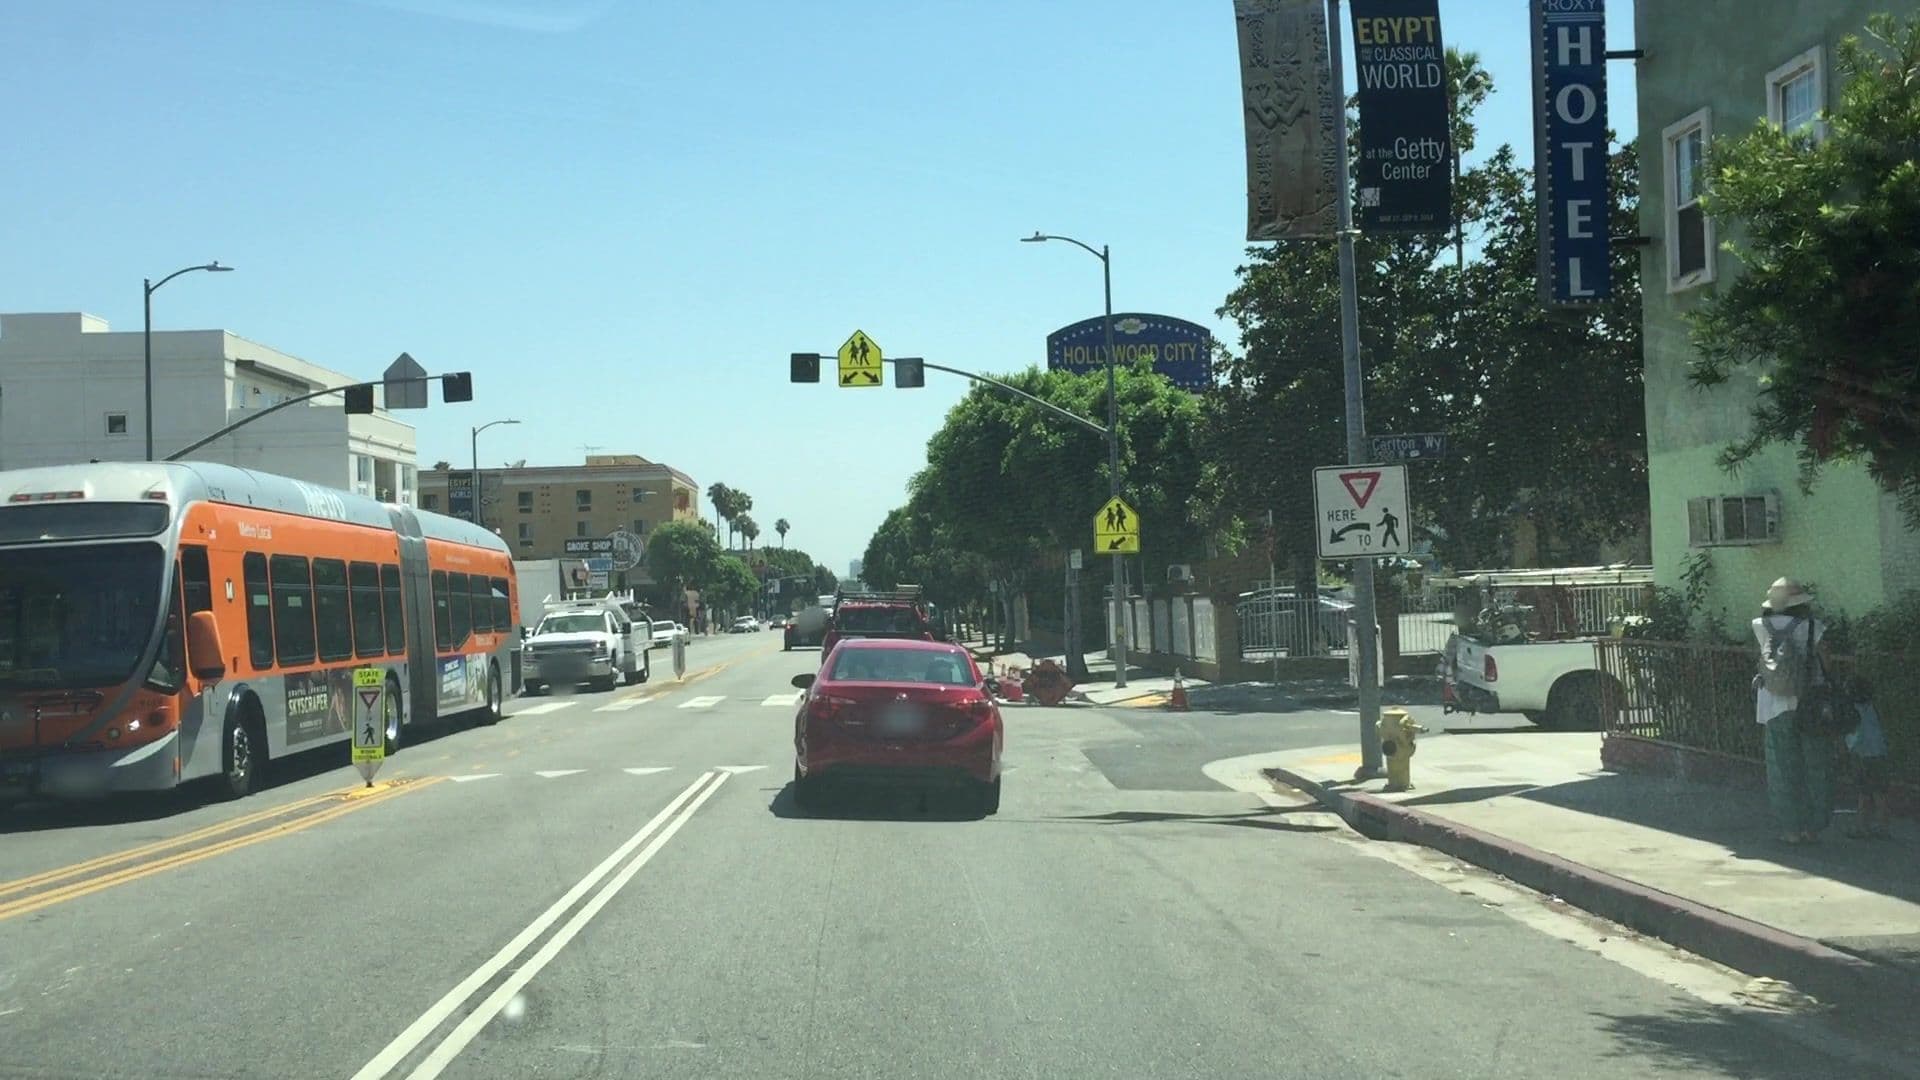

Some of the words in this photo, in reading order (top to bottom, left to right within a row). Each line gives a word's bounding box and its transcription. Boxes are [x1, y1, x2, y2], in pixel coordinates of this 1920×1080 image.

[1547, 0, 1597, 10] ROXY
[1357, 16, 1435, 44] EGYPT
[1374, 46, 1440, 61] CLASSICAL
[1362, 63, 1440, 89] WORLD
[1366, 149, 1375, 159] at
[1378, 148, 1393, 159] the
[1395, 137, 1445, 163] Getty
[1555, 26, 1598, 297] HOTEL
[1382, 162, 1431, 180] Center
[1063, 344, 1160, 365] HOLLYWOOD
[1164, 343, 1198, 362] CITY
[1372, 438, 1415, 452] Carlton
[1424, 435, 1442, 452] Wy
[1327, 509, 1357, 521] HERE
[566, 541, 590, 552] SMOKE
[591, 540, 612, 551] SHOP
[1358, 534, 1371, 546] TO
[359, 670, 380, 678] STATE
[288, 693, 329, 716] SKYSCRAPER
